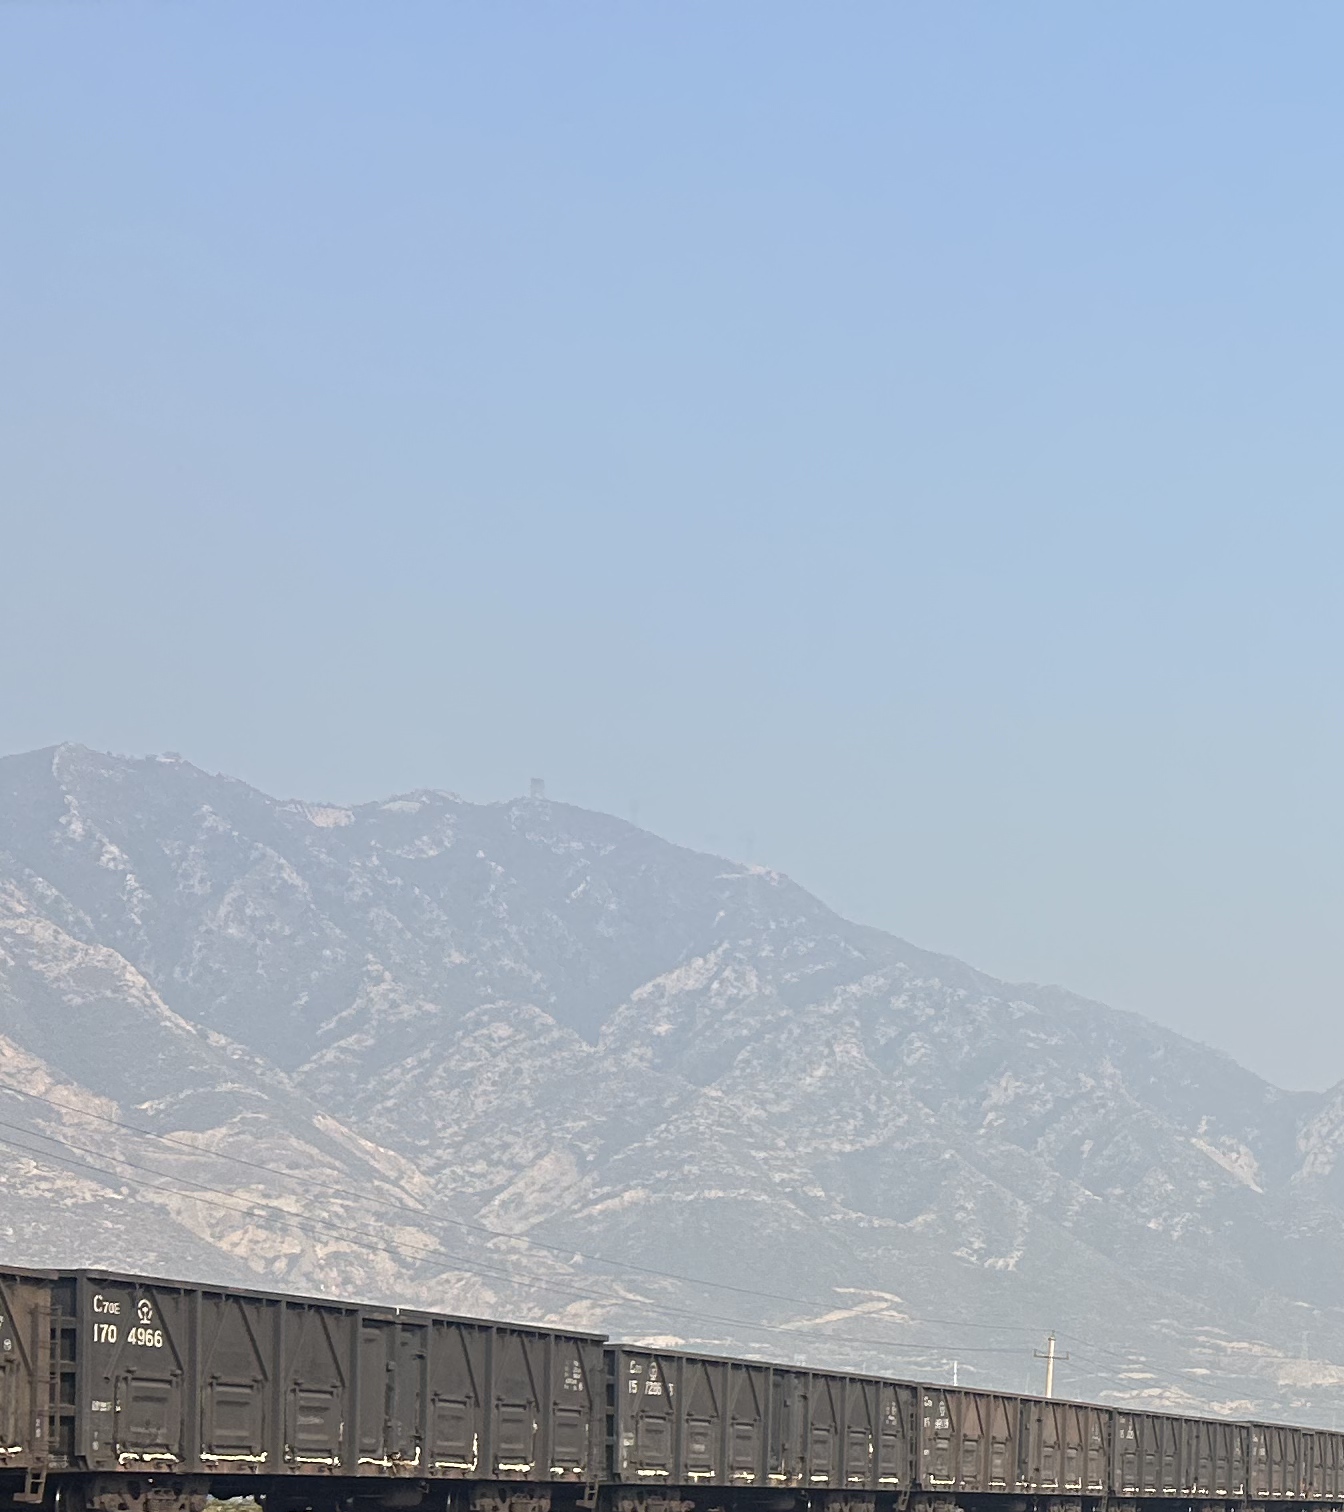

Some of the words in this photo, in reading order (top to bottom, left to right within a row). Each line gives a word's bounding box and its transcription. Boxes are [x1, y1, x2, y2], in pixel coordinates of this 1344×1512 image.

[93, 1294, 120, 1314] C70E
[93, 1323, 118, 1343] 170
[127, 1327, 163, 1348] 4966
